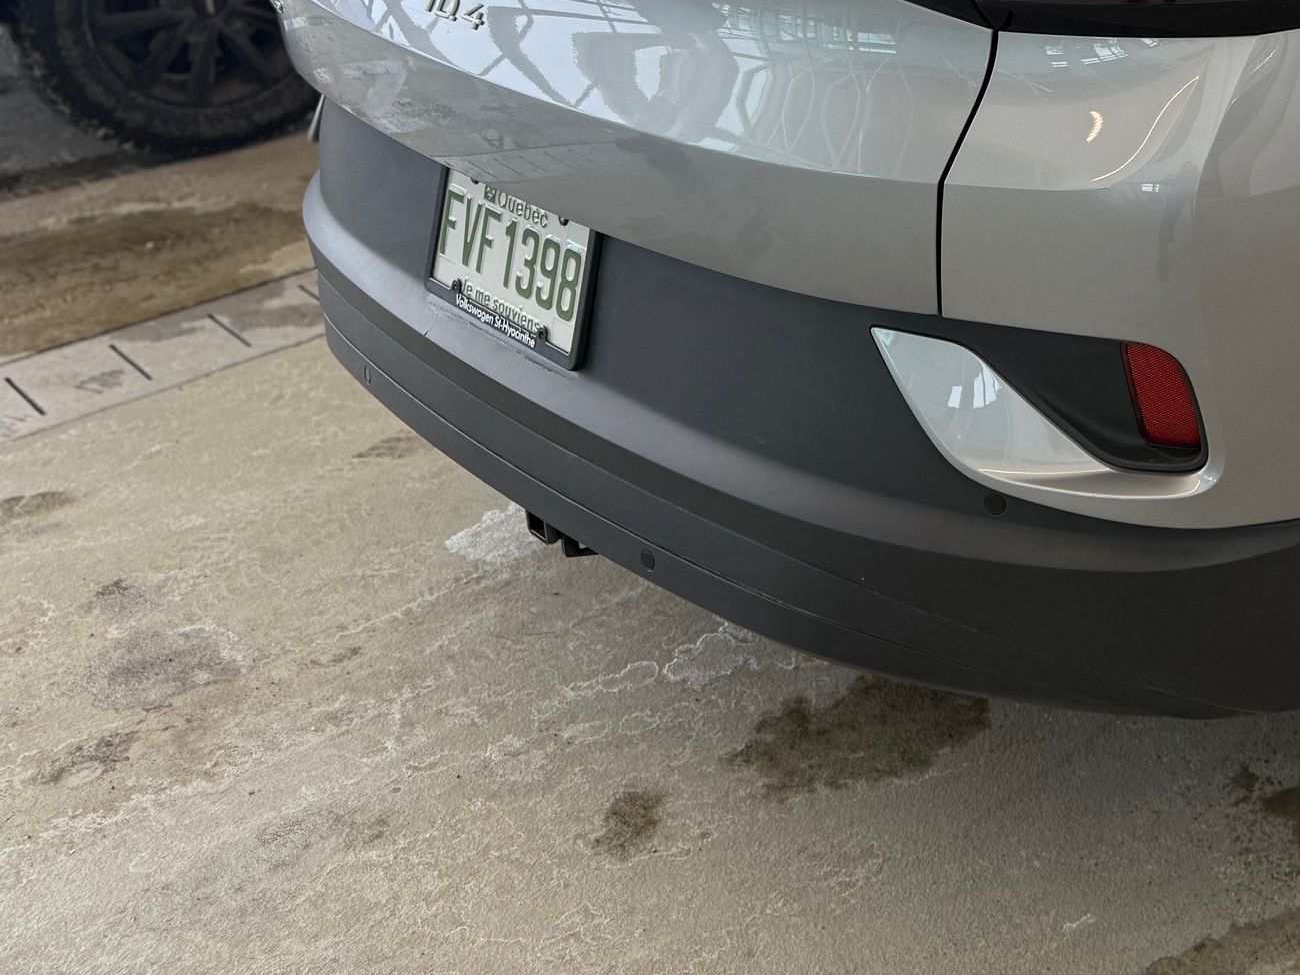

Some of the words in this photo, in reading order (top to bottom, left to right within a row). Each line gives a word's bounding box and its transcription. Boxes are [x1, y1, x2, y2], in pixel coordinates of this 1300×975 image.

[455, 292, 495, 325] Volkswagen
[475, 289, 491, 306] me
[492, 298, 540, 333] souviens
